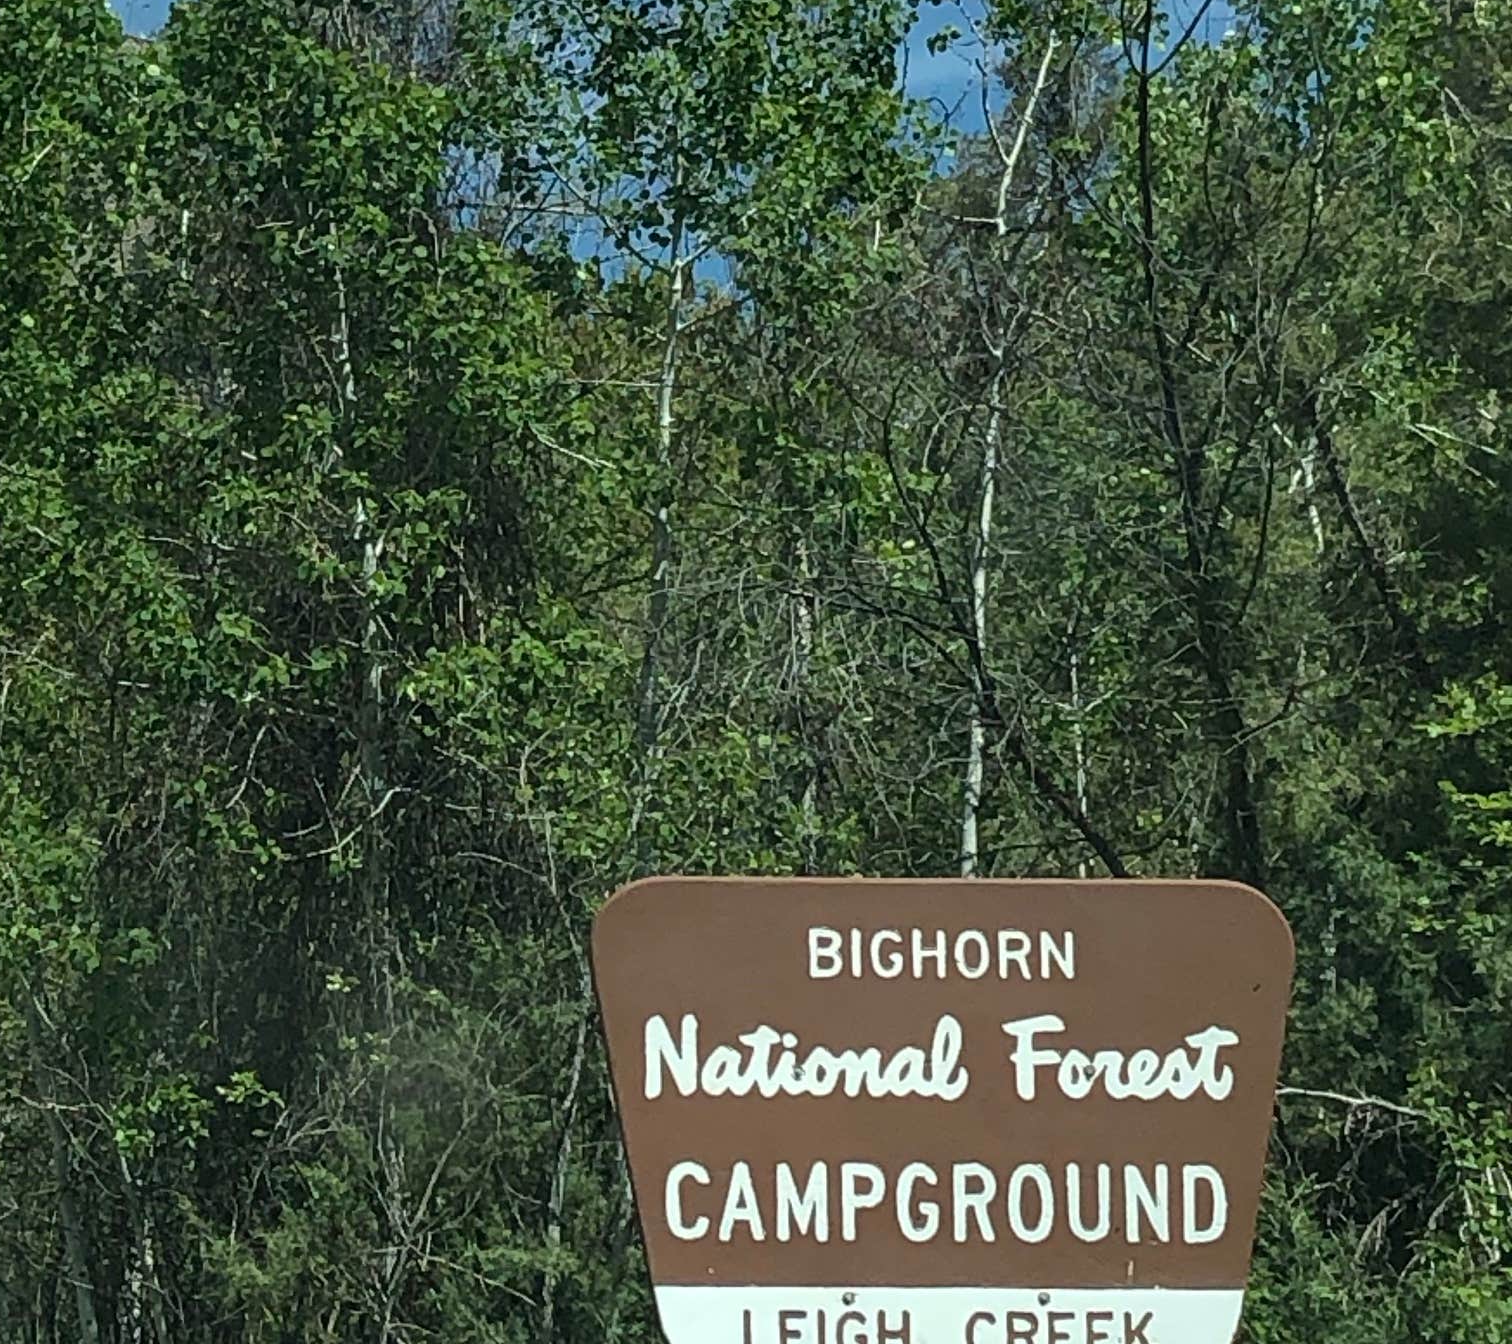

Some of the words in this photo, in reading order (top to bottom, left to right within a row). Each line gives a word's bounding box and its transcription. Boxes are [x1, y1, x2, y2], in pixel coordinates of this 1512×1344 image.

[807, 927, 1076, 981] BIGHORN
[644, 1014, 969, 1101] National
[1001, 1014, 1240, 1101] Forest
[664, 1161, 1229, 1245] CAMPGROUND
